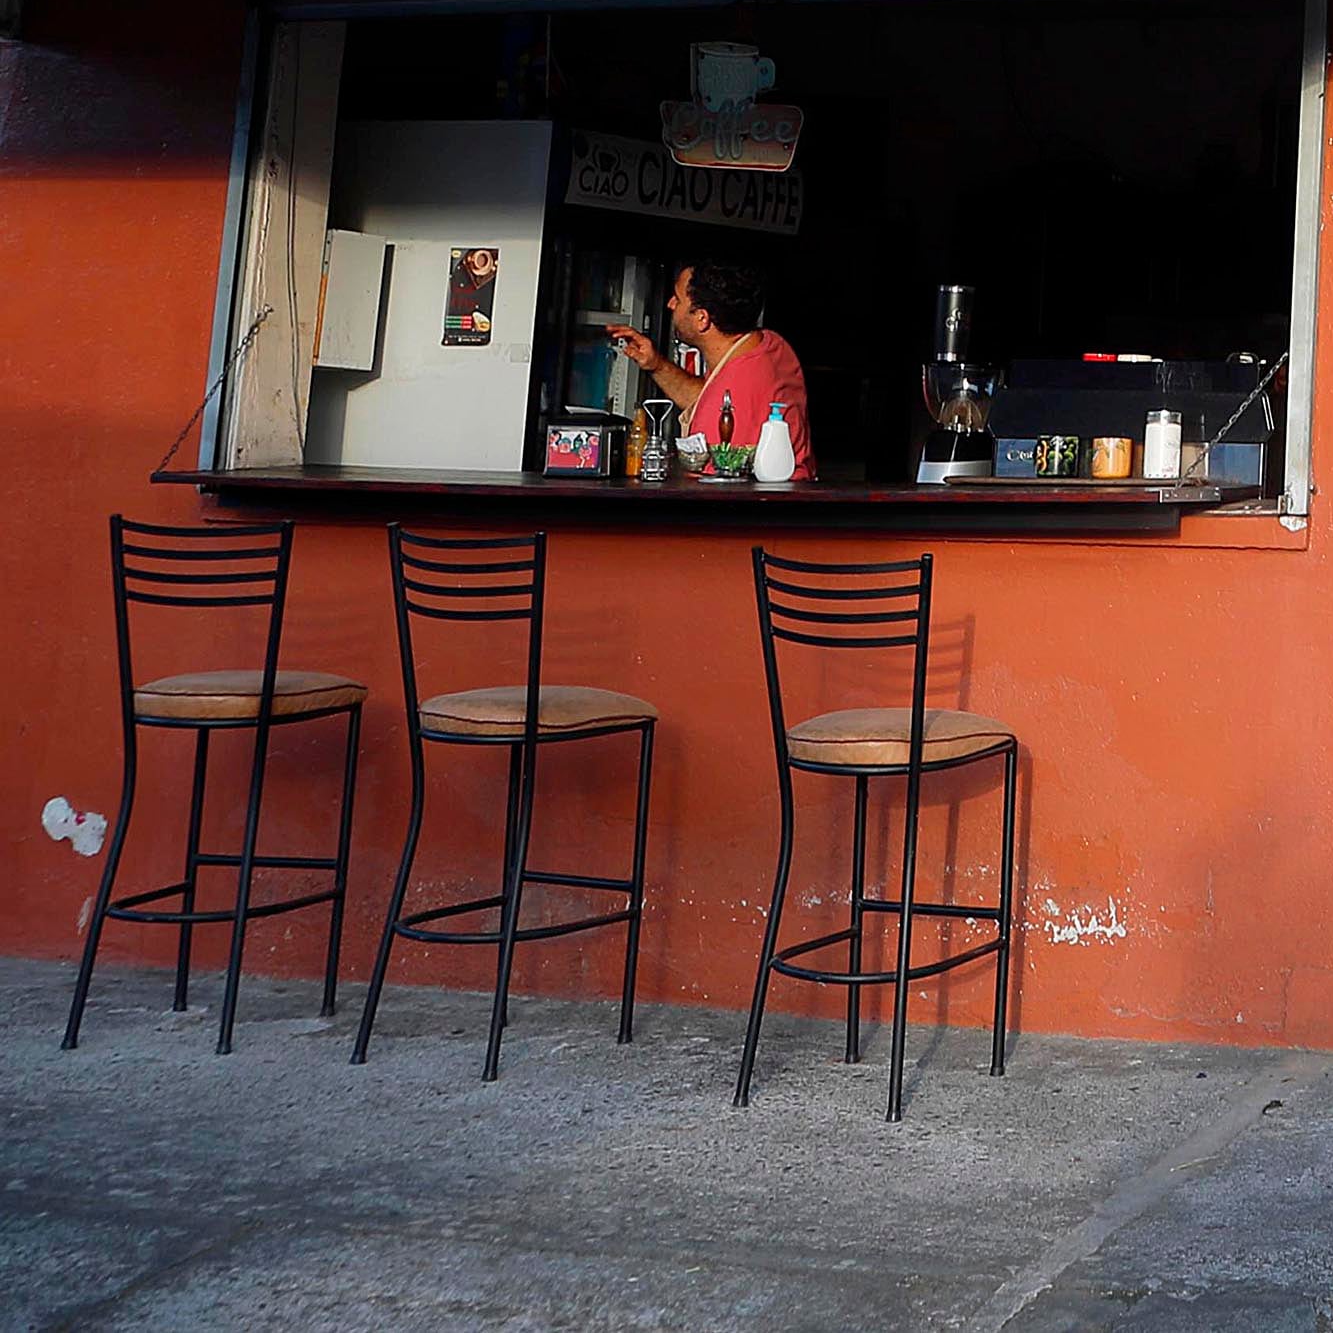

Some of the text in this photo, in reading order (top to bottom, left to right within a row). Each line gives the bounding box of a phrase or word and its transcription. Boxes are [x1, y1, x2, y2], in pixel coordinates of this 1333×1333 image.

[671, 100, 797, 159] Coffee
[579, 166, 629, 197] CIAO
[638, 152, 713, 212] CIAO
